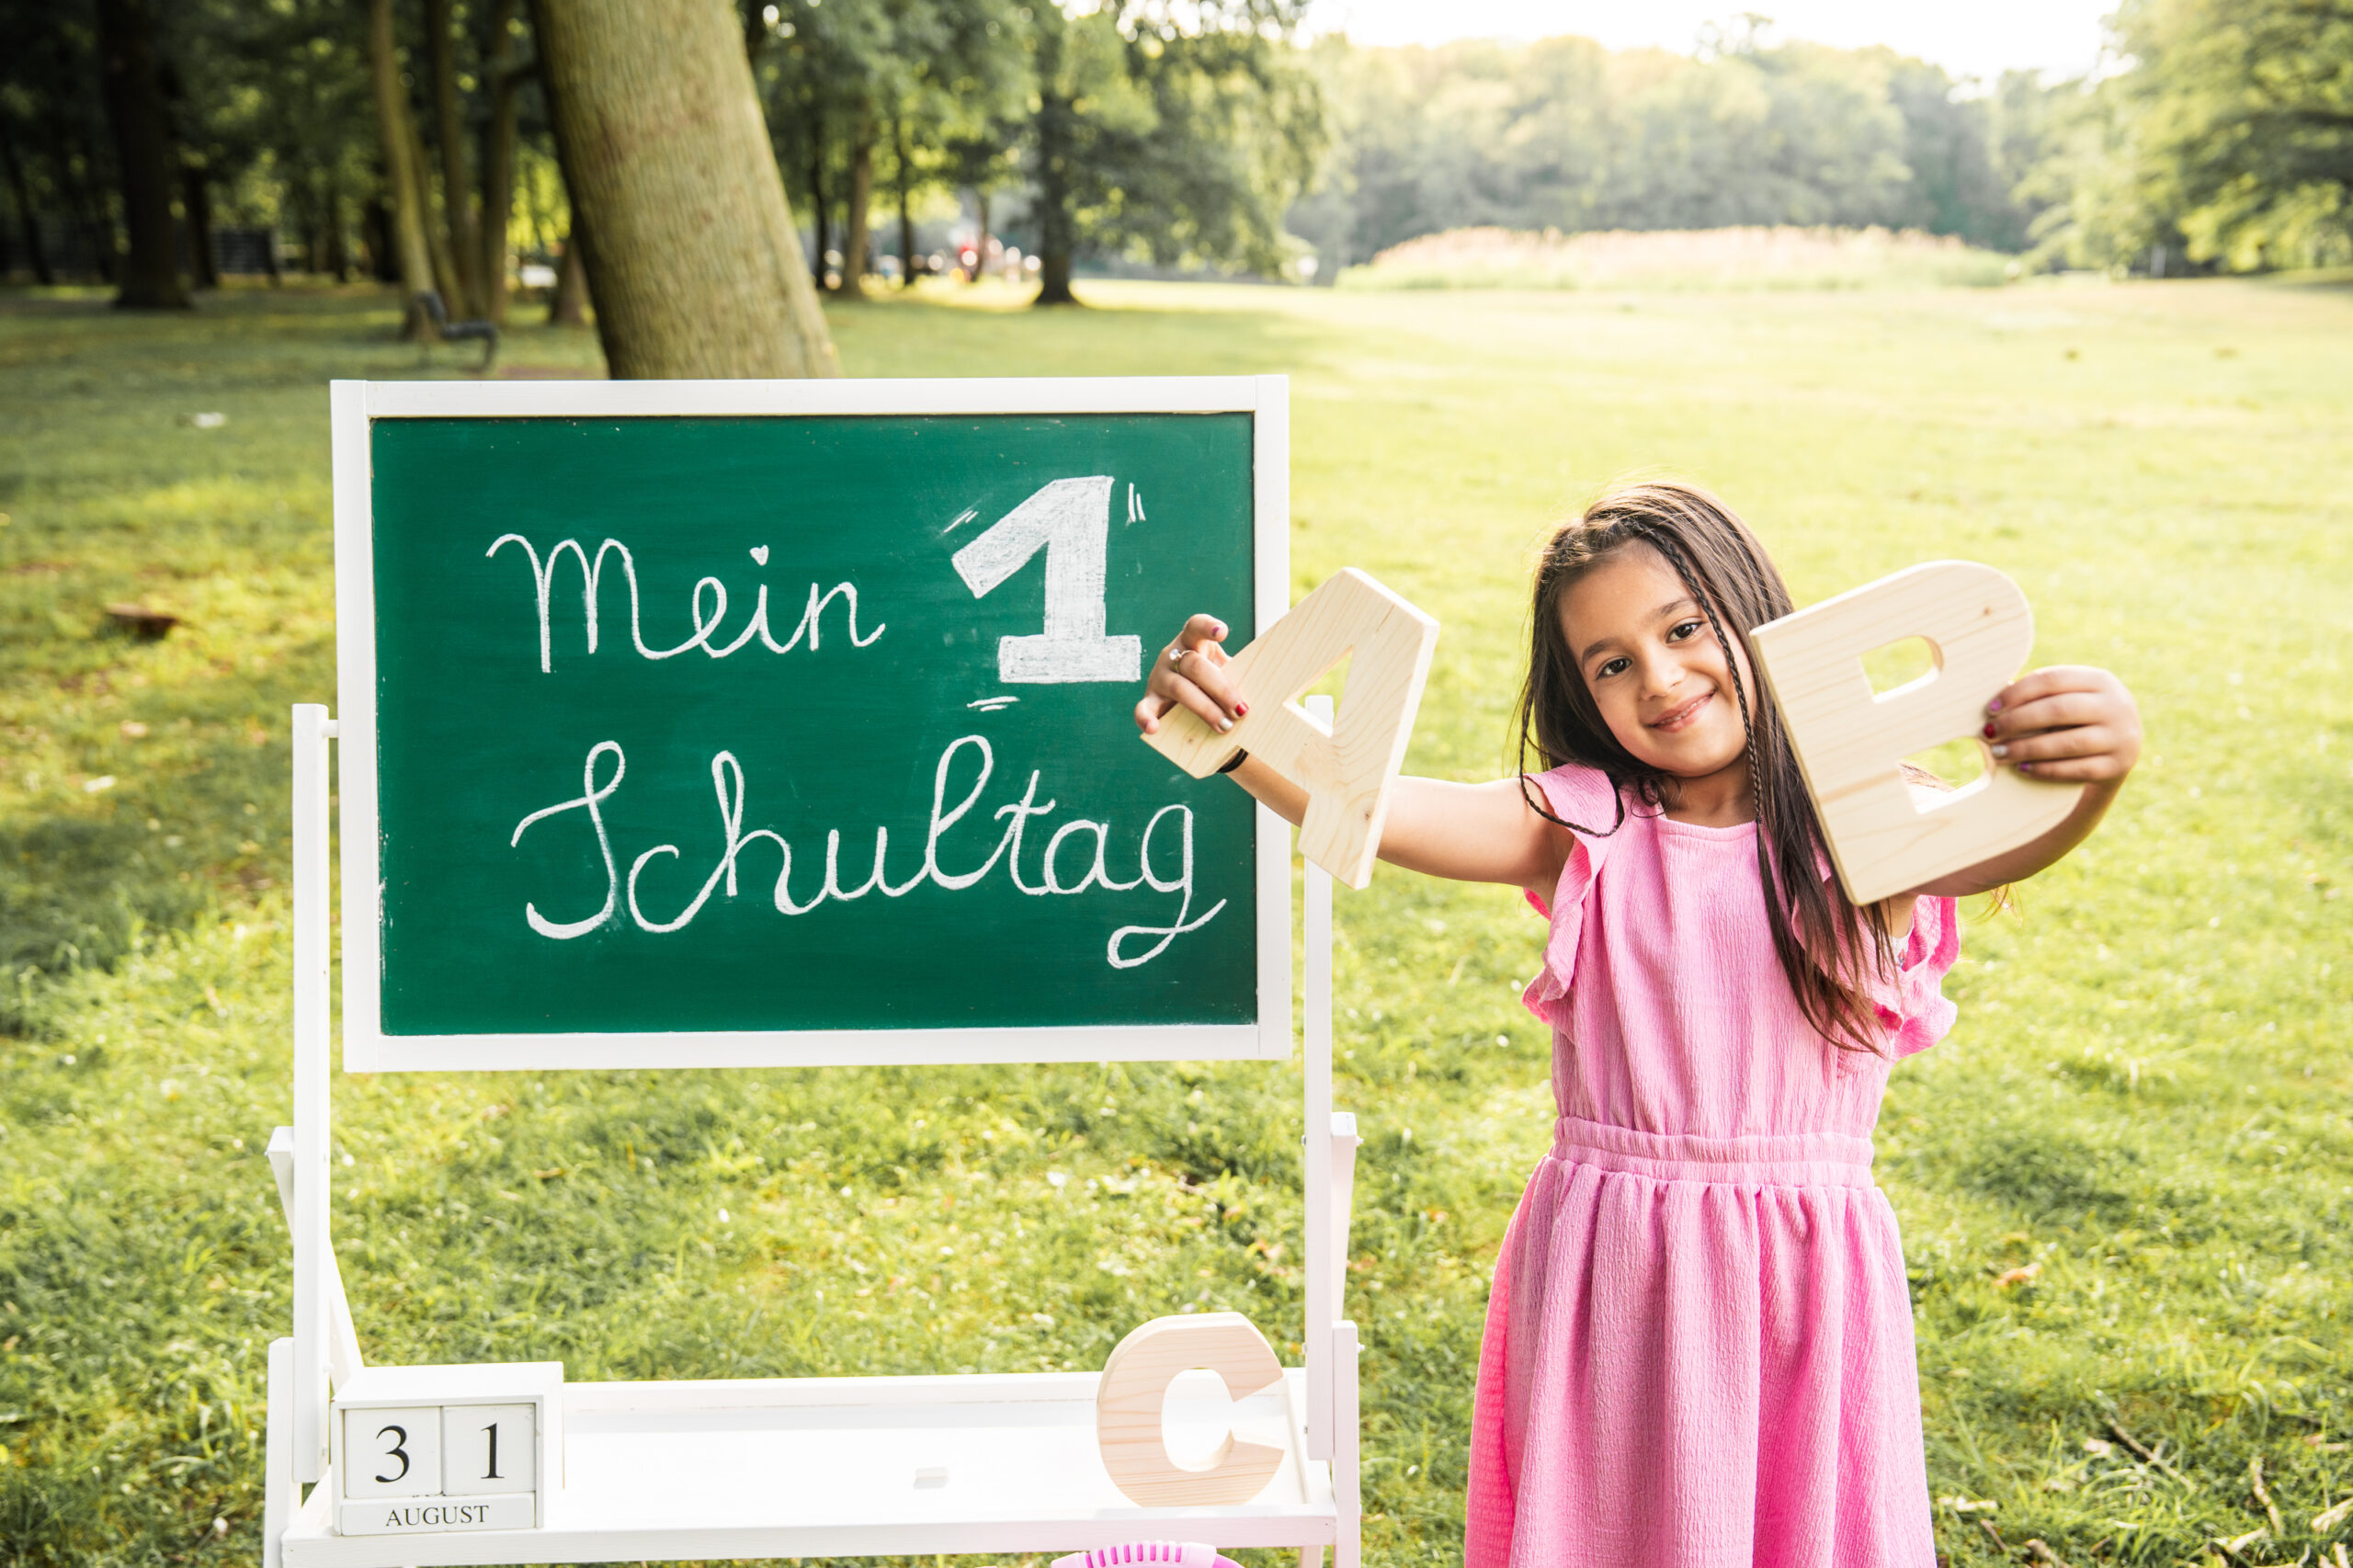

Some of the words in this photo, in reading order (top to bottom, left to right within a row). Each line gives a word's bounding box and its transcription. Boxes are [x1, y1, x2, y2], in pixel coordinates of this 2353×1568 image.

[485, 532, 887, 675] Mein
[949, 474, 1143, 685] 1
[1139, 566, 1439, 891] A
[1749, 560, 2086, 907] B
[509, 734, 1229, 970] Schultag
[384, 1505, 490, 1528] AUGUST
[1096, 1311, 1285, 1508] C
